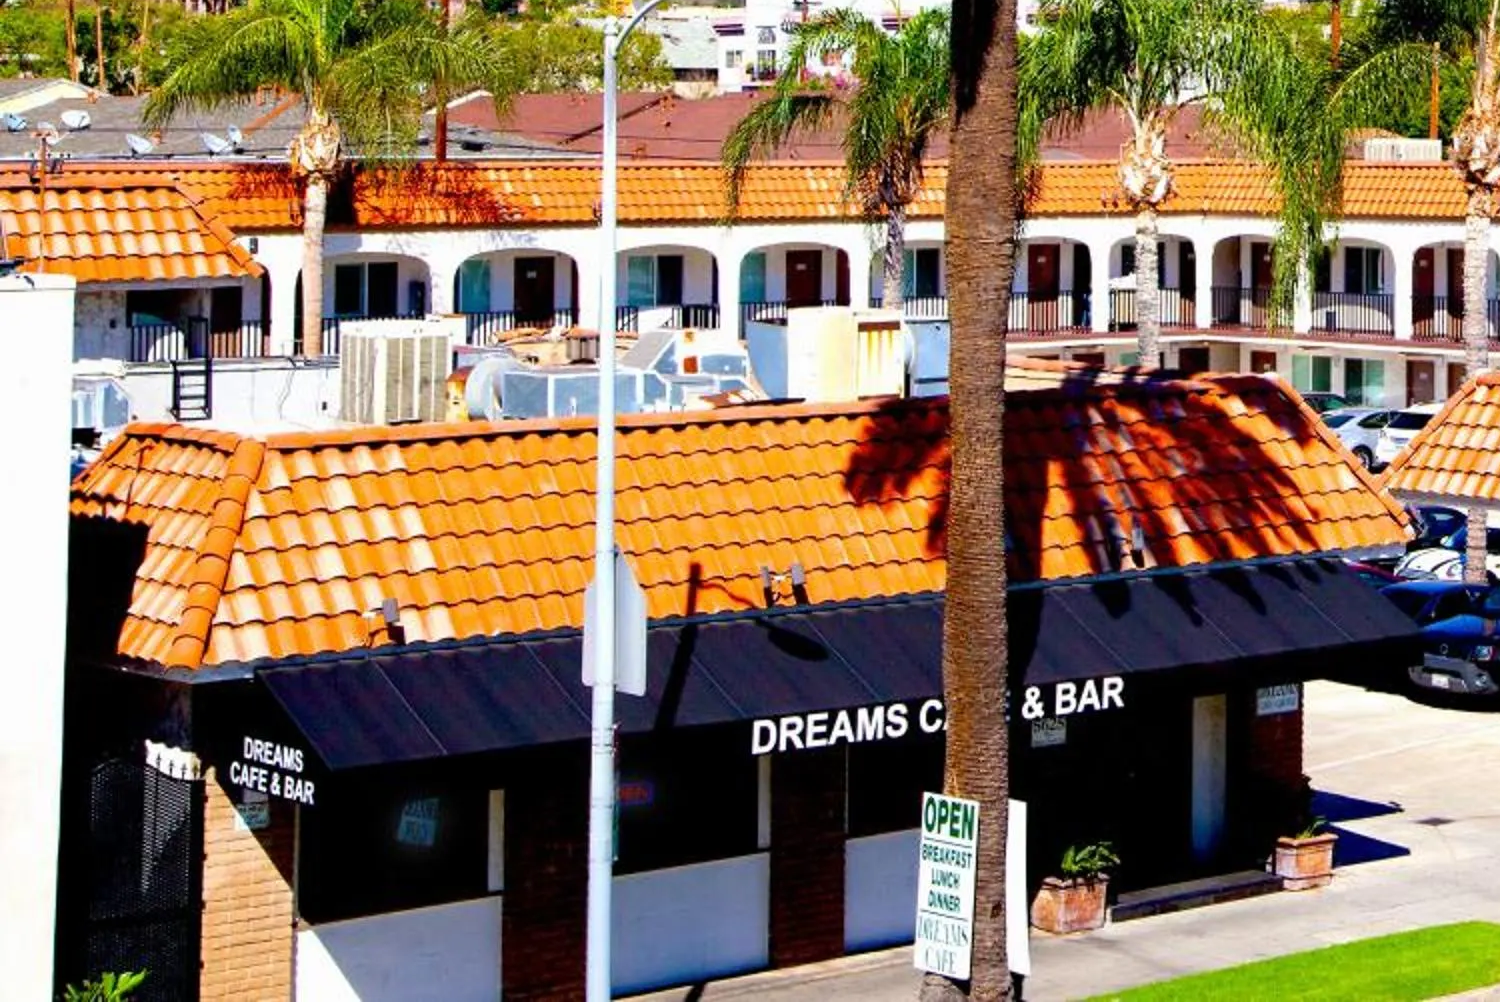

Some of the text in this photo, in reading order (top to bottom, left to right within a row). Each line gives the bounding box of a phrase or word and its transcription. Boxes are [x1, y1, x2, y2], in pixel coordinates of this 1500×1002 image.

[751, 703, 908, 755] DREAMS
[1022, 686, 1045, 720] &
[1055, 676, 1125, 715] BAR
[243, 736, 304, 773] DREAMS
[229, 761, 315, 805] CAFE & BAR
[924, 796, 976, 840] OPEN
[921, 843, 972, 870] BREAKFAST
[931, 868, 961, 889] LUNCH
[927, 890, 961, 912] DINNER
